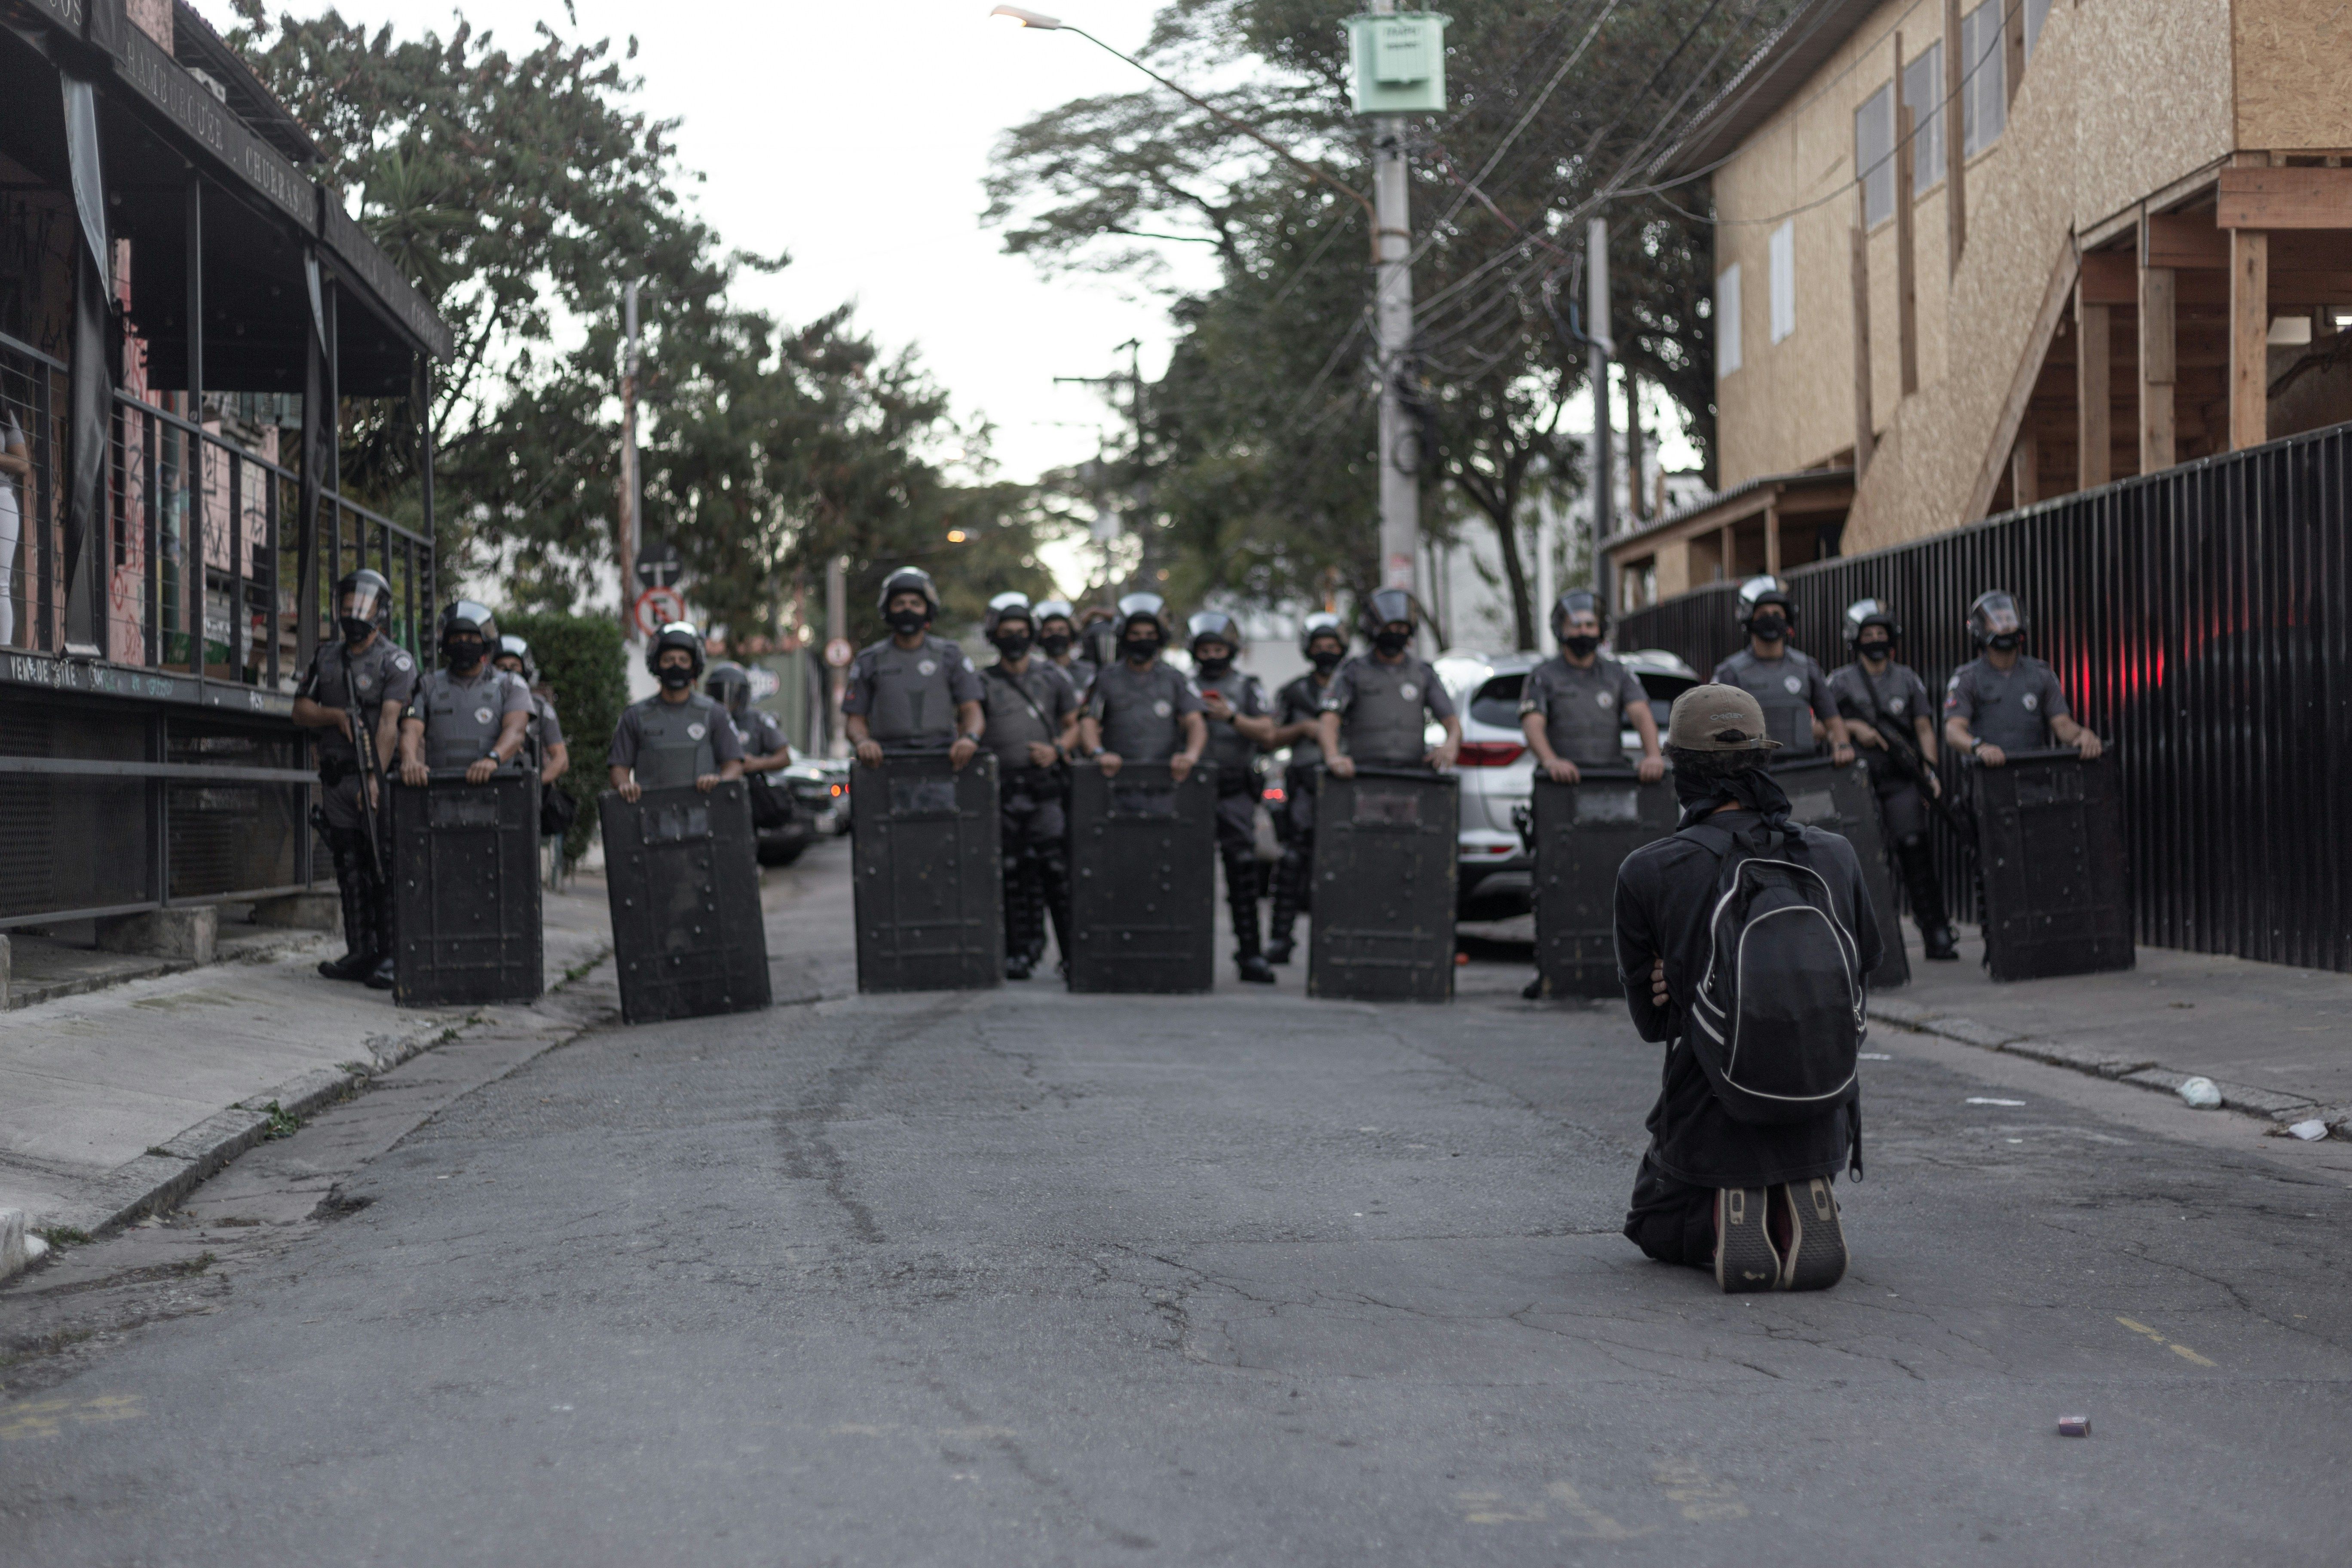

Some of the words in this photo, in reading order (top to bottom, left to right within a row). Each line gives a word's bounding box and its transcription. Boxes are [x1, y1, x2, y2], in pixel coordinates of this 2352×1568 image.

[127, 41, 223, 151] HAMBURGUER
[245, 146, 314, 224] CHURRASCO
[36, 658, 49, 683] DE
